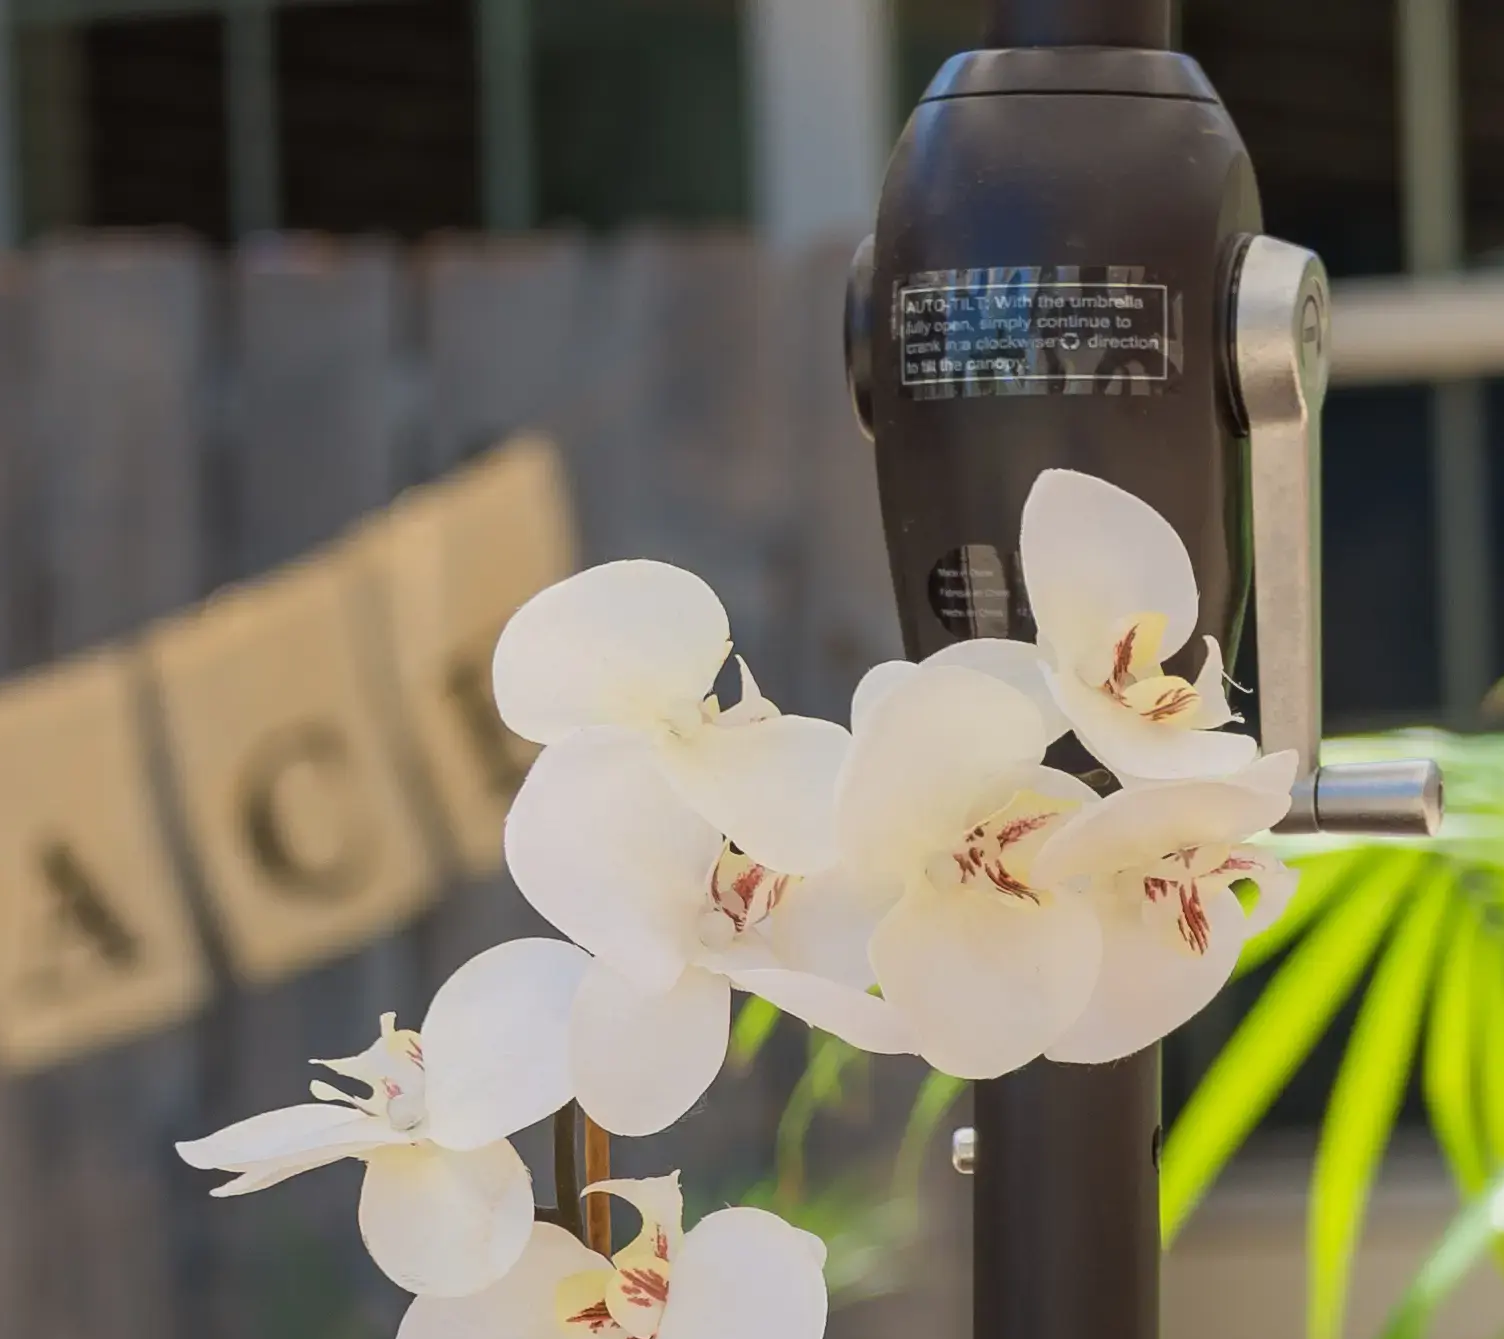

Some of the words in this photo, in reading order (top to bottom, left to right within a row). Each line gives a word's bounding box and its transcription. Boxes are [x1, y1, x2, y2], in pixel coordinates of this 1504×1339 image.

[994, 295, 1033, 309] With
[1037, 295, 1065, 308] the
[1069, 295, 1144, 309] umbrella
[906, 320, 932, 337] fully
[933, 320, 975, 335] open,
[979, 315, 1032, 332] simply
[1037, 315, 1111, 329] continue
[1115, 316, 1132, 329] to
[906, 341, 942, 355] crank
[976, 335, 1056, 350] clockwise
[1087, 333, 1159, 350] direction
[906, 361, 919, 375] to
[939, 357, 963, 373] the
